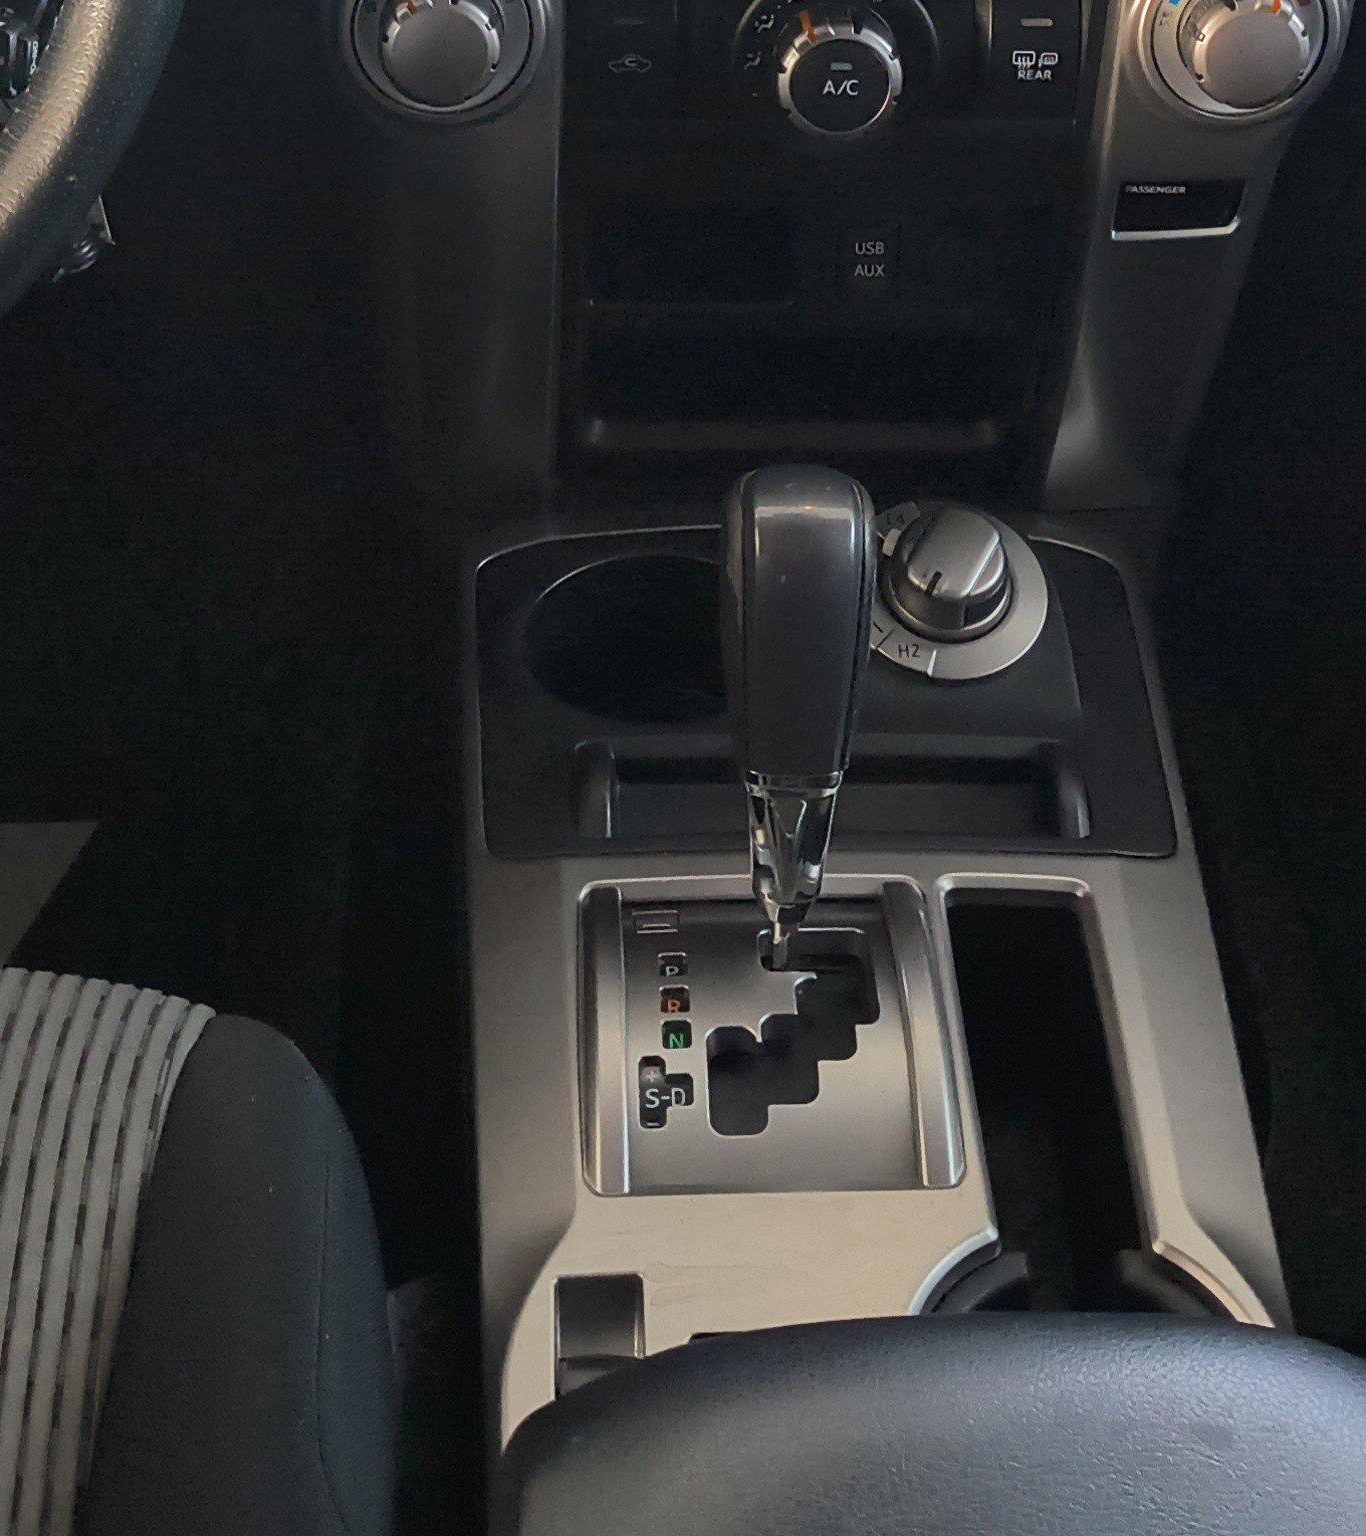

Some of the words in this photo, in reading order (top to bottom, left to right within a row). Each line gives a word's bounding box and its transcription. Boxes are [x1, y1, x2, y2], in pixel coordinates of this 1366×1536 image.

[1017, 68, 1052, 82] REAR
[822, 80, 860, 96] A/C
[1125, 185, 1186, 194] PASSENGER
[855, 241, 885, 255] USB
[854, 264, 885, 277] AUX
[898, 643, 920, 658] H2
[665, 965, 680, 977] P
[667, 998, 682, 1013] R
[669, 1032, 685, 1050] N
